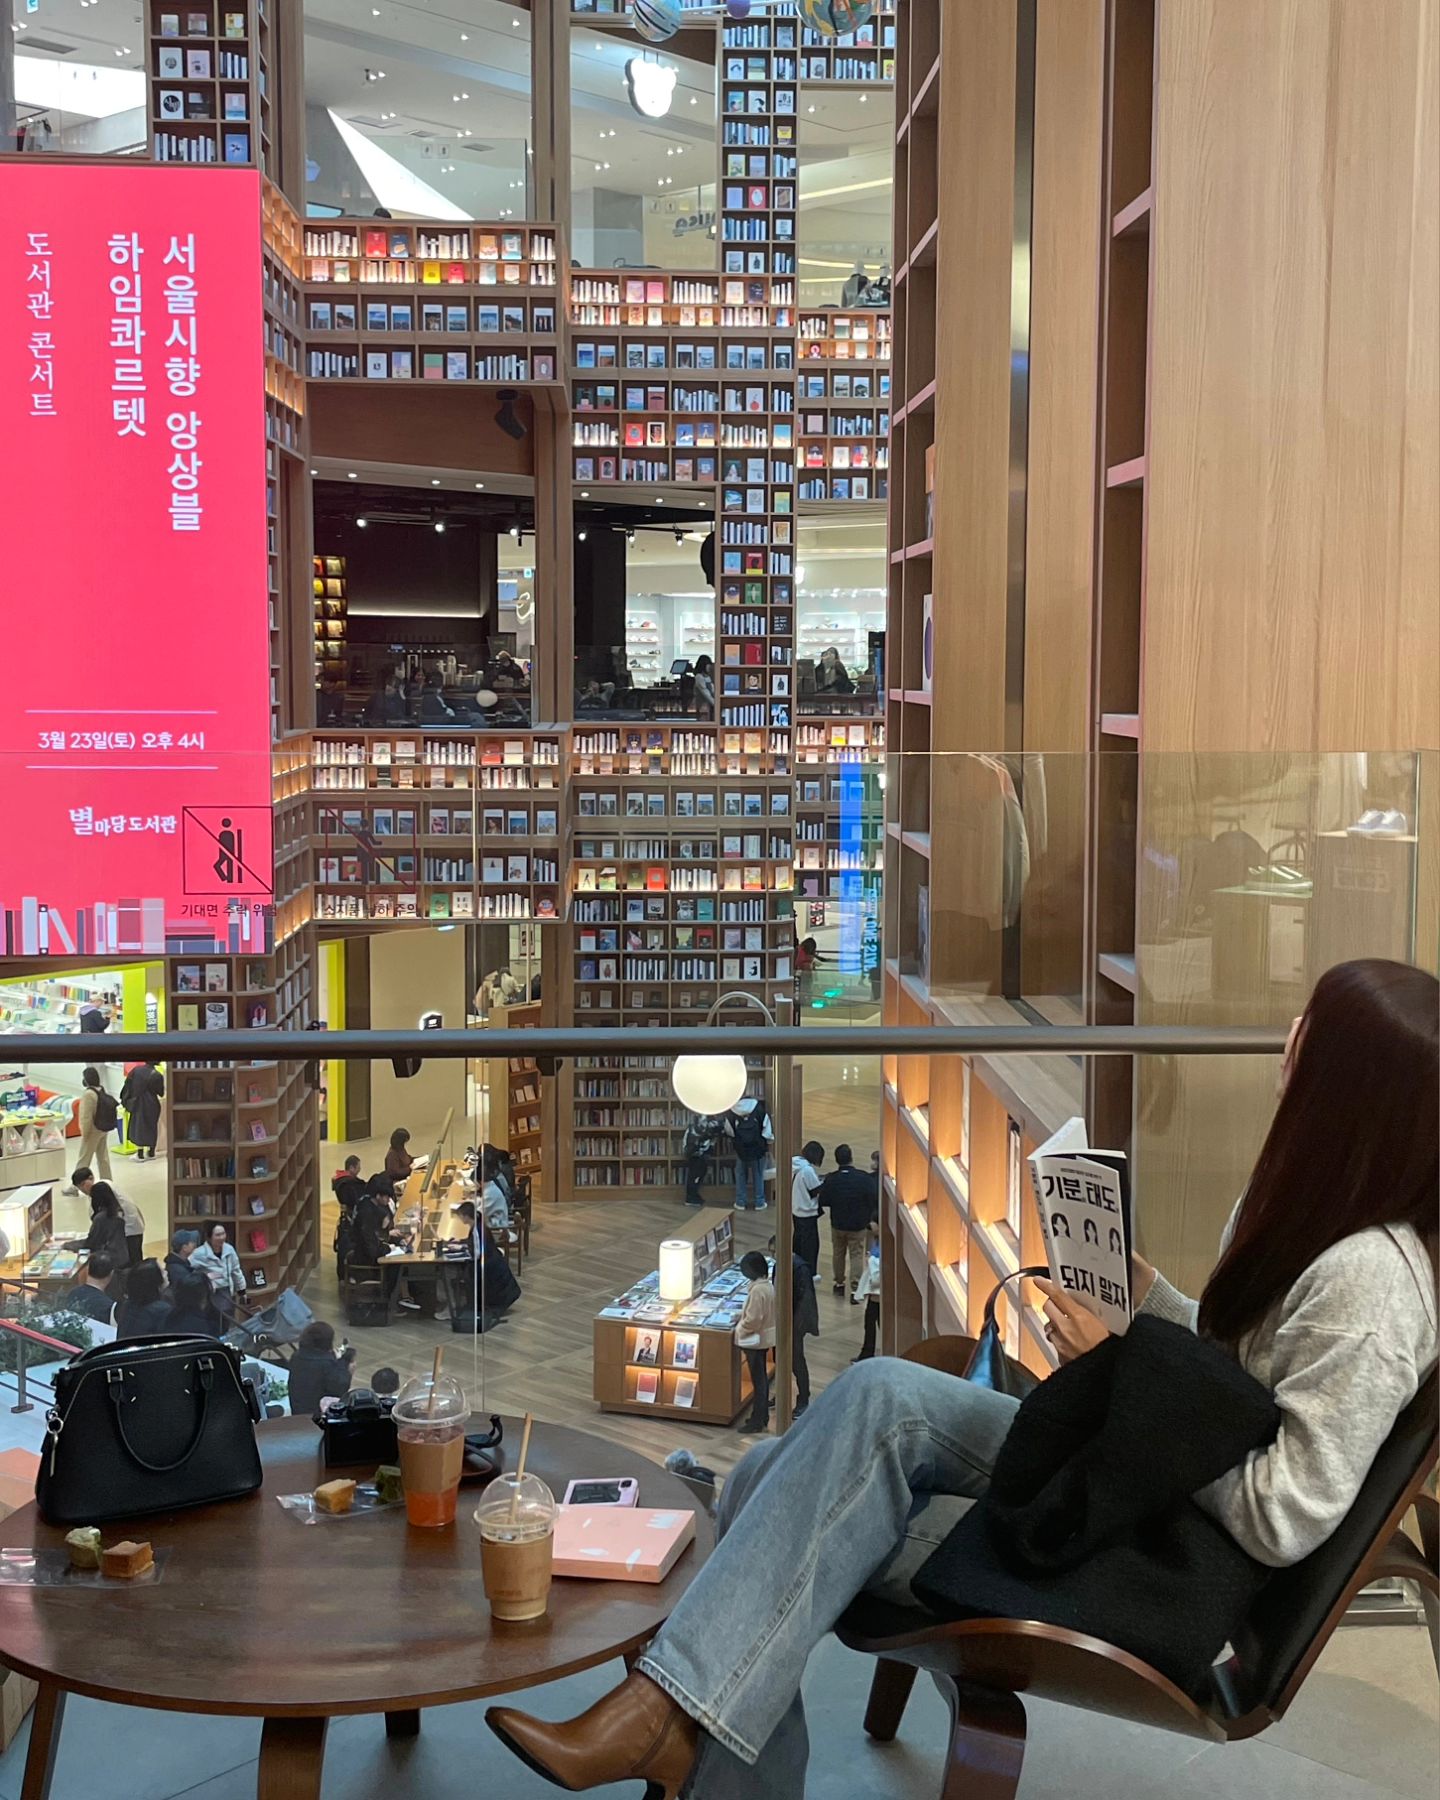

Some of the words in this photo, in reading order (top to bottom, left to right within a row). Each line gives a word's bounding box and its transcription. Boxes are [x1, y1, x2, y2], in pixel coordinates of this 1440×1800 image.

[25, 232, 54, 319] 도서관
[162, 233, 201, 397] 서울시향
[28, 332, 57, 416] 콘서트
[107, 231, 147, 437] 하임콰르텟
[166, 411, 203, 531] 앙상블
[38, 731, 66, 749] 3월
[70, 731, 136, 749] 23일(토)
[141, 731, 174, 749] 오후
[177, 731, 205, 750] 4시
[128, 815, 177, 834] 도서관
[181, 904, 218, 917] 기대면
[222, 903, 247, 917] 추락
[1060, 1265, 1095, 1297] 되지
[1099, 1275, 1126, 1313] 말자
